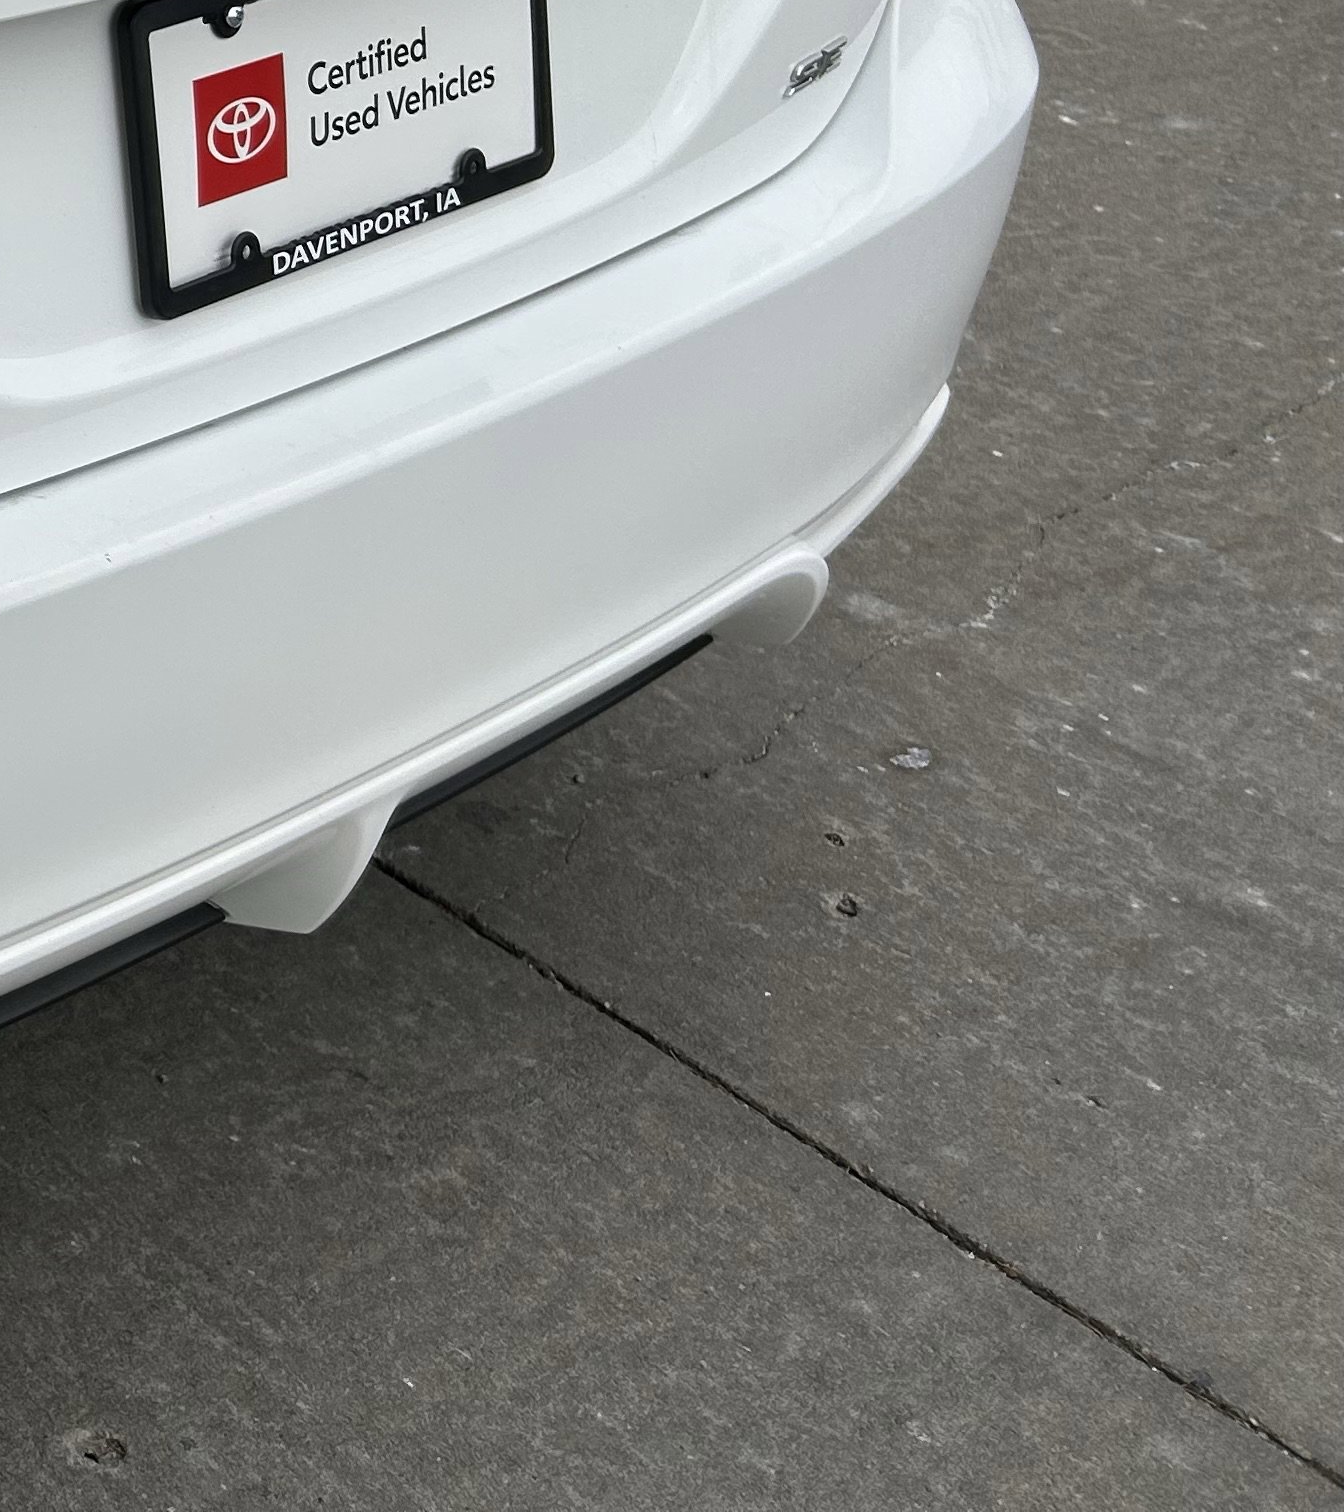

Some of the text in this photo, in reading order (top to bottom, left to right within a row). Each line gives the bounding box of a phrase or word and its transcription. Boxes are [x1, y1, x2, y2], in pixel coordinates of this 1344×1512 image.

[307, 26, 428, 95] Certified
[310, 62, 496, 147] Used Vehicles
[272, 186, 462, 276] DAVENPORT, IA
